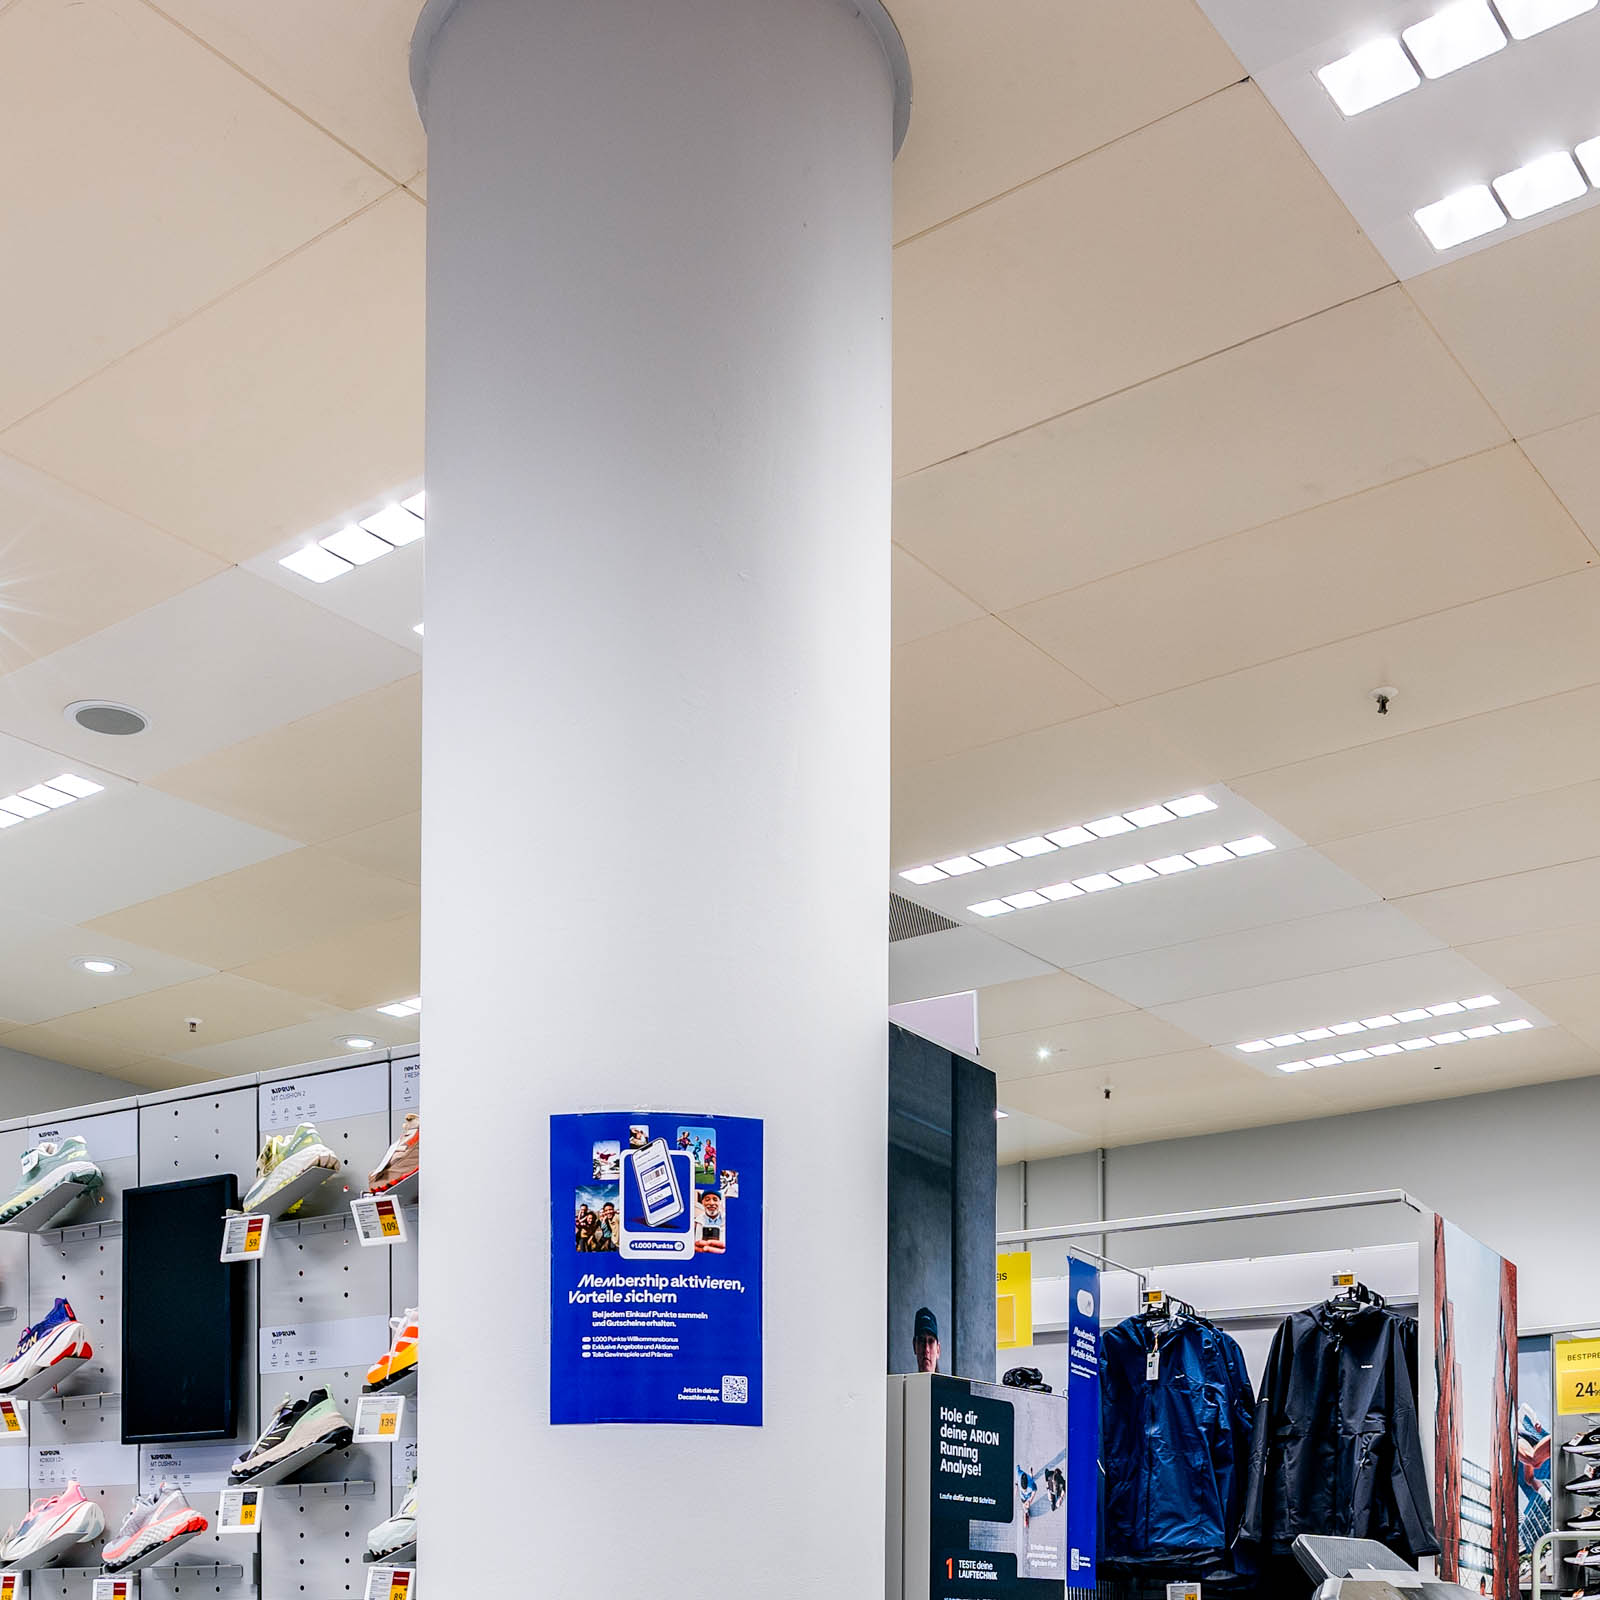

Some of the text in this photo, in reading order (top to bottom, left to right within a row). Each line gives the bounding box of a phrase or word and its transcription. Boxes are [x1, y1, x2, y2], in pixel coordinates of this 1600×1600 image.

[577, 1274, 745, 1293] Membership aktivieren,
[568, 1289, 677, 1304] Vorteile sichern
[604, 1311, 625, 1319] jedem
[940, 1406, 978, 1425] Hole dir
[940, 1423, 999, 1446] deine ARION
[940, 1441, 978, 1463] Running
[940, 1458, 982, 1478] Analyse!
[946, 1557, 953, 1580] 1
[959, 1560, 993, 1570] TESTE deine
[959, 1569, 998, 1580] LAUFTECHNIK
